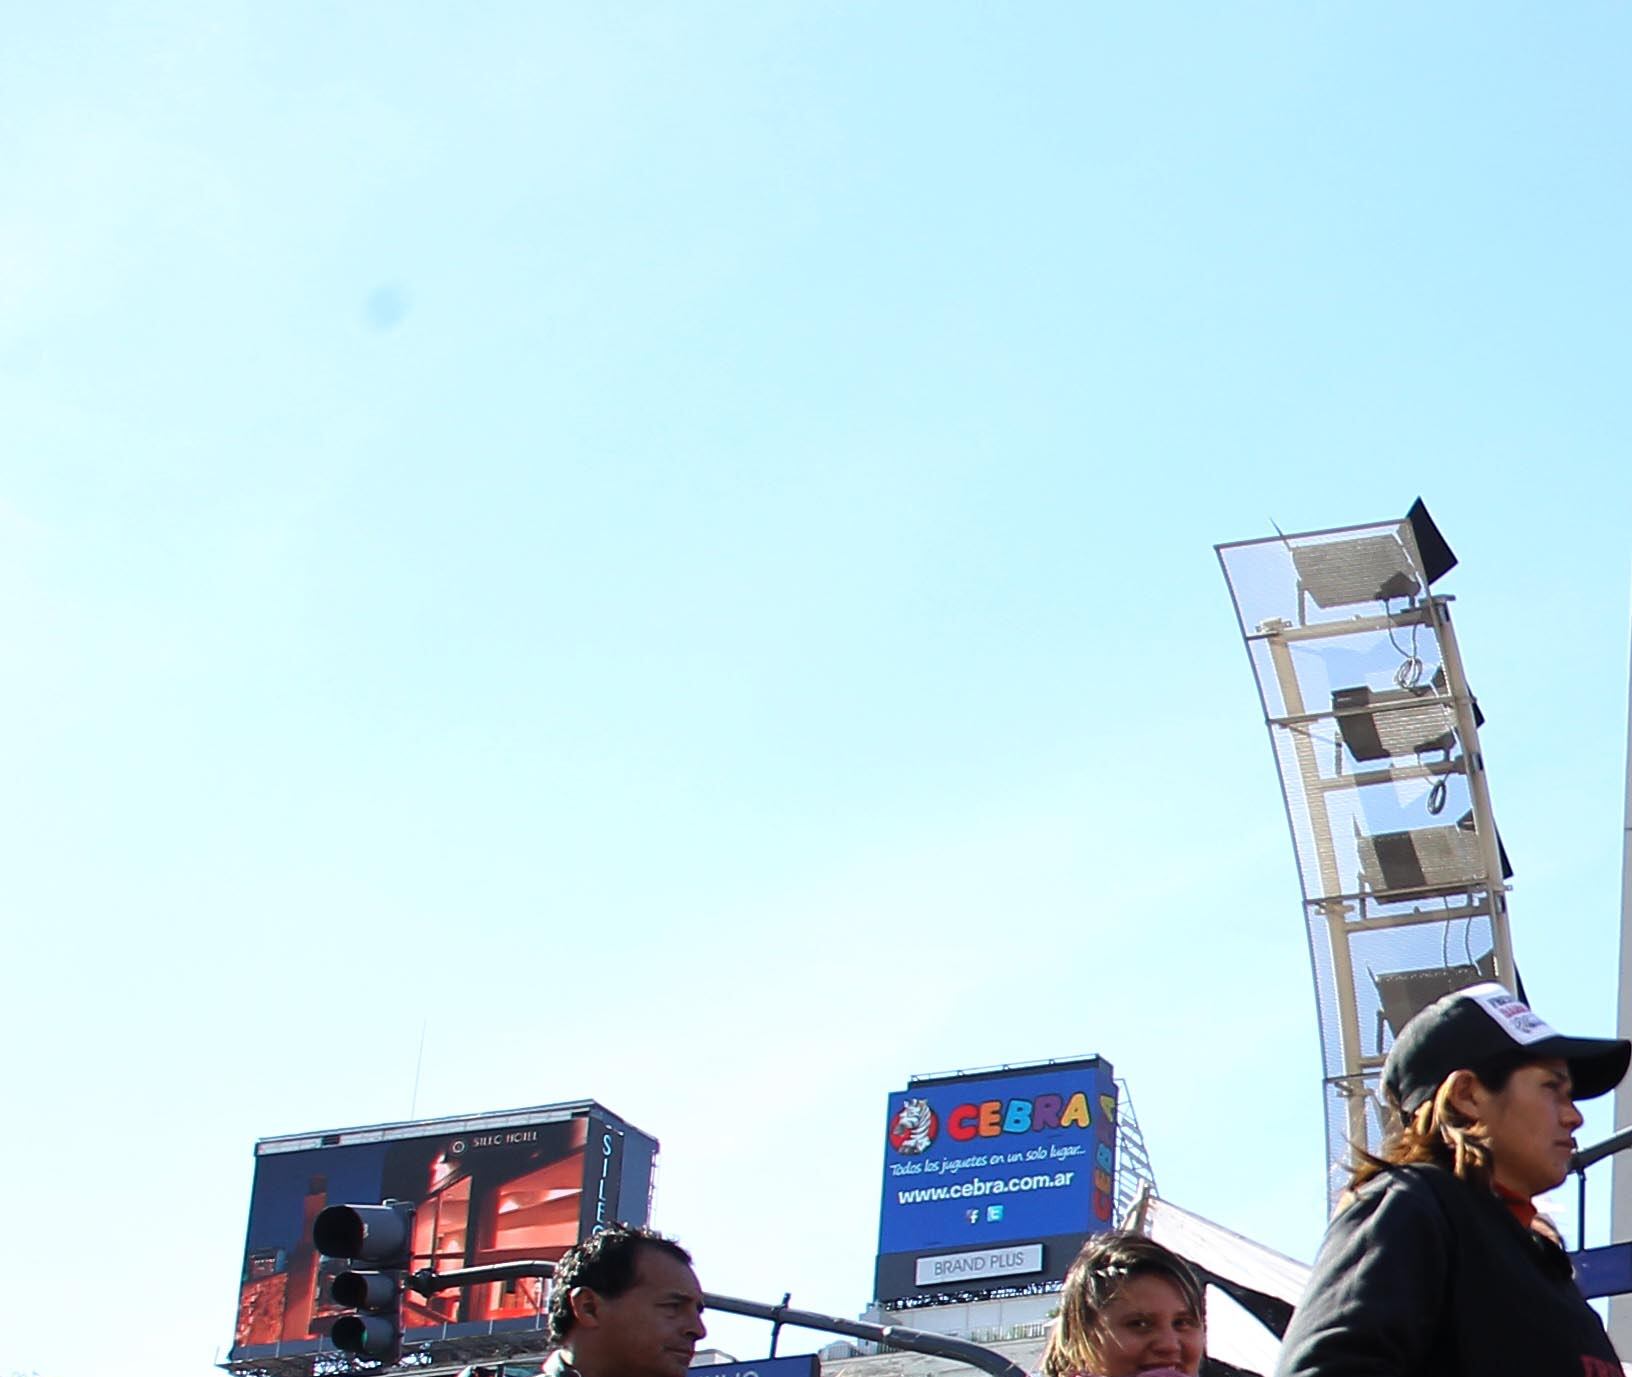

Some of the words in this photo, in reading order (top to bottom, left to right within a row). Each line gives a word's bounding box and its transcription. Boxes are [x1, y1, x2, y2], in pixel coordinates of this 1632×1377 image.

[947, 1090, 1092, 1142] CEBRA
[889, 1158, 922, 1177] Todos
[924, 1157, 940, 1173] los
[938, 1154, 988, 1175] juguetes
[990, 1153, 1005, 1165] en
[1007, 1151, 1023, 1162] un
[1025, 1147, 1048, 1162] solo
[898, 1170, 1075, 1205] www.cebra.com.ar
[933, 1253, 987, 1277] BRAND
[989, 1251, 1025, 1269] PLUS
